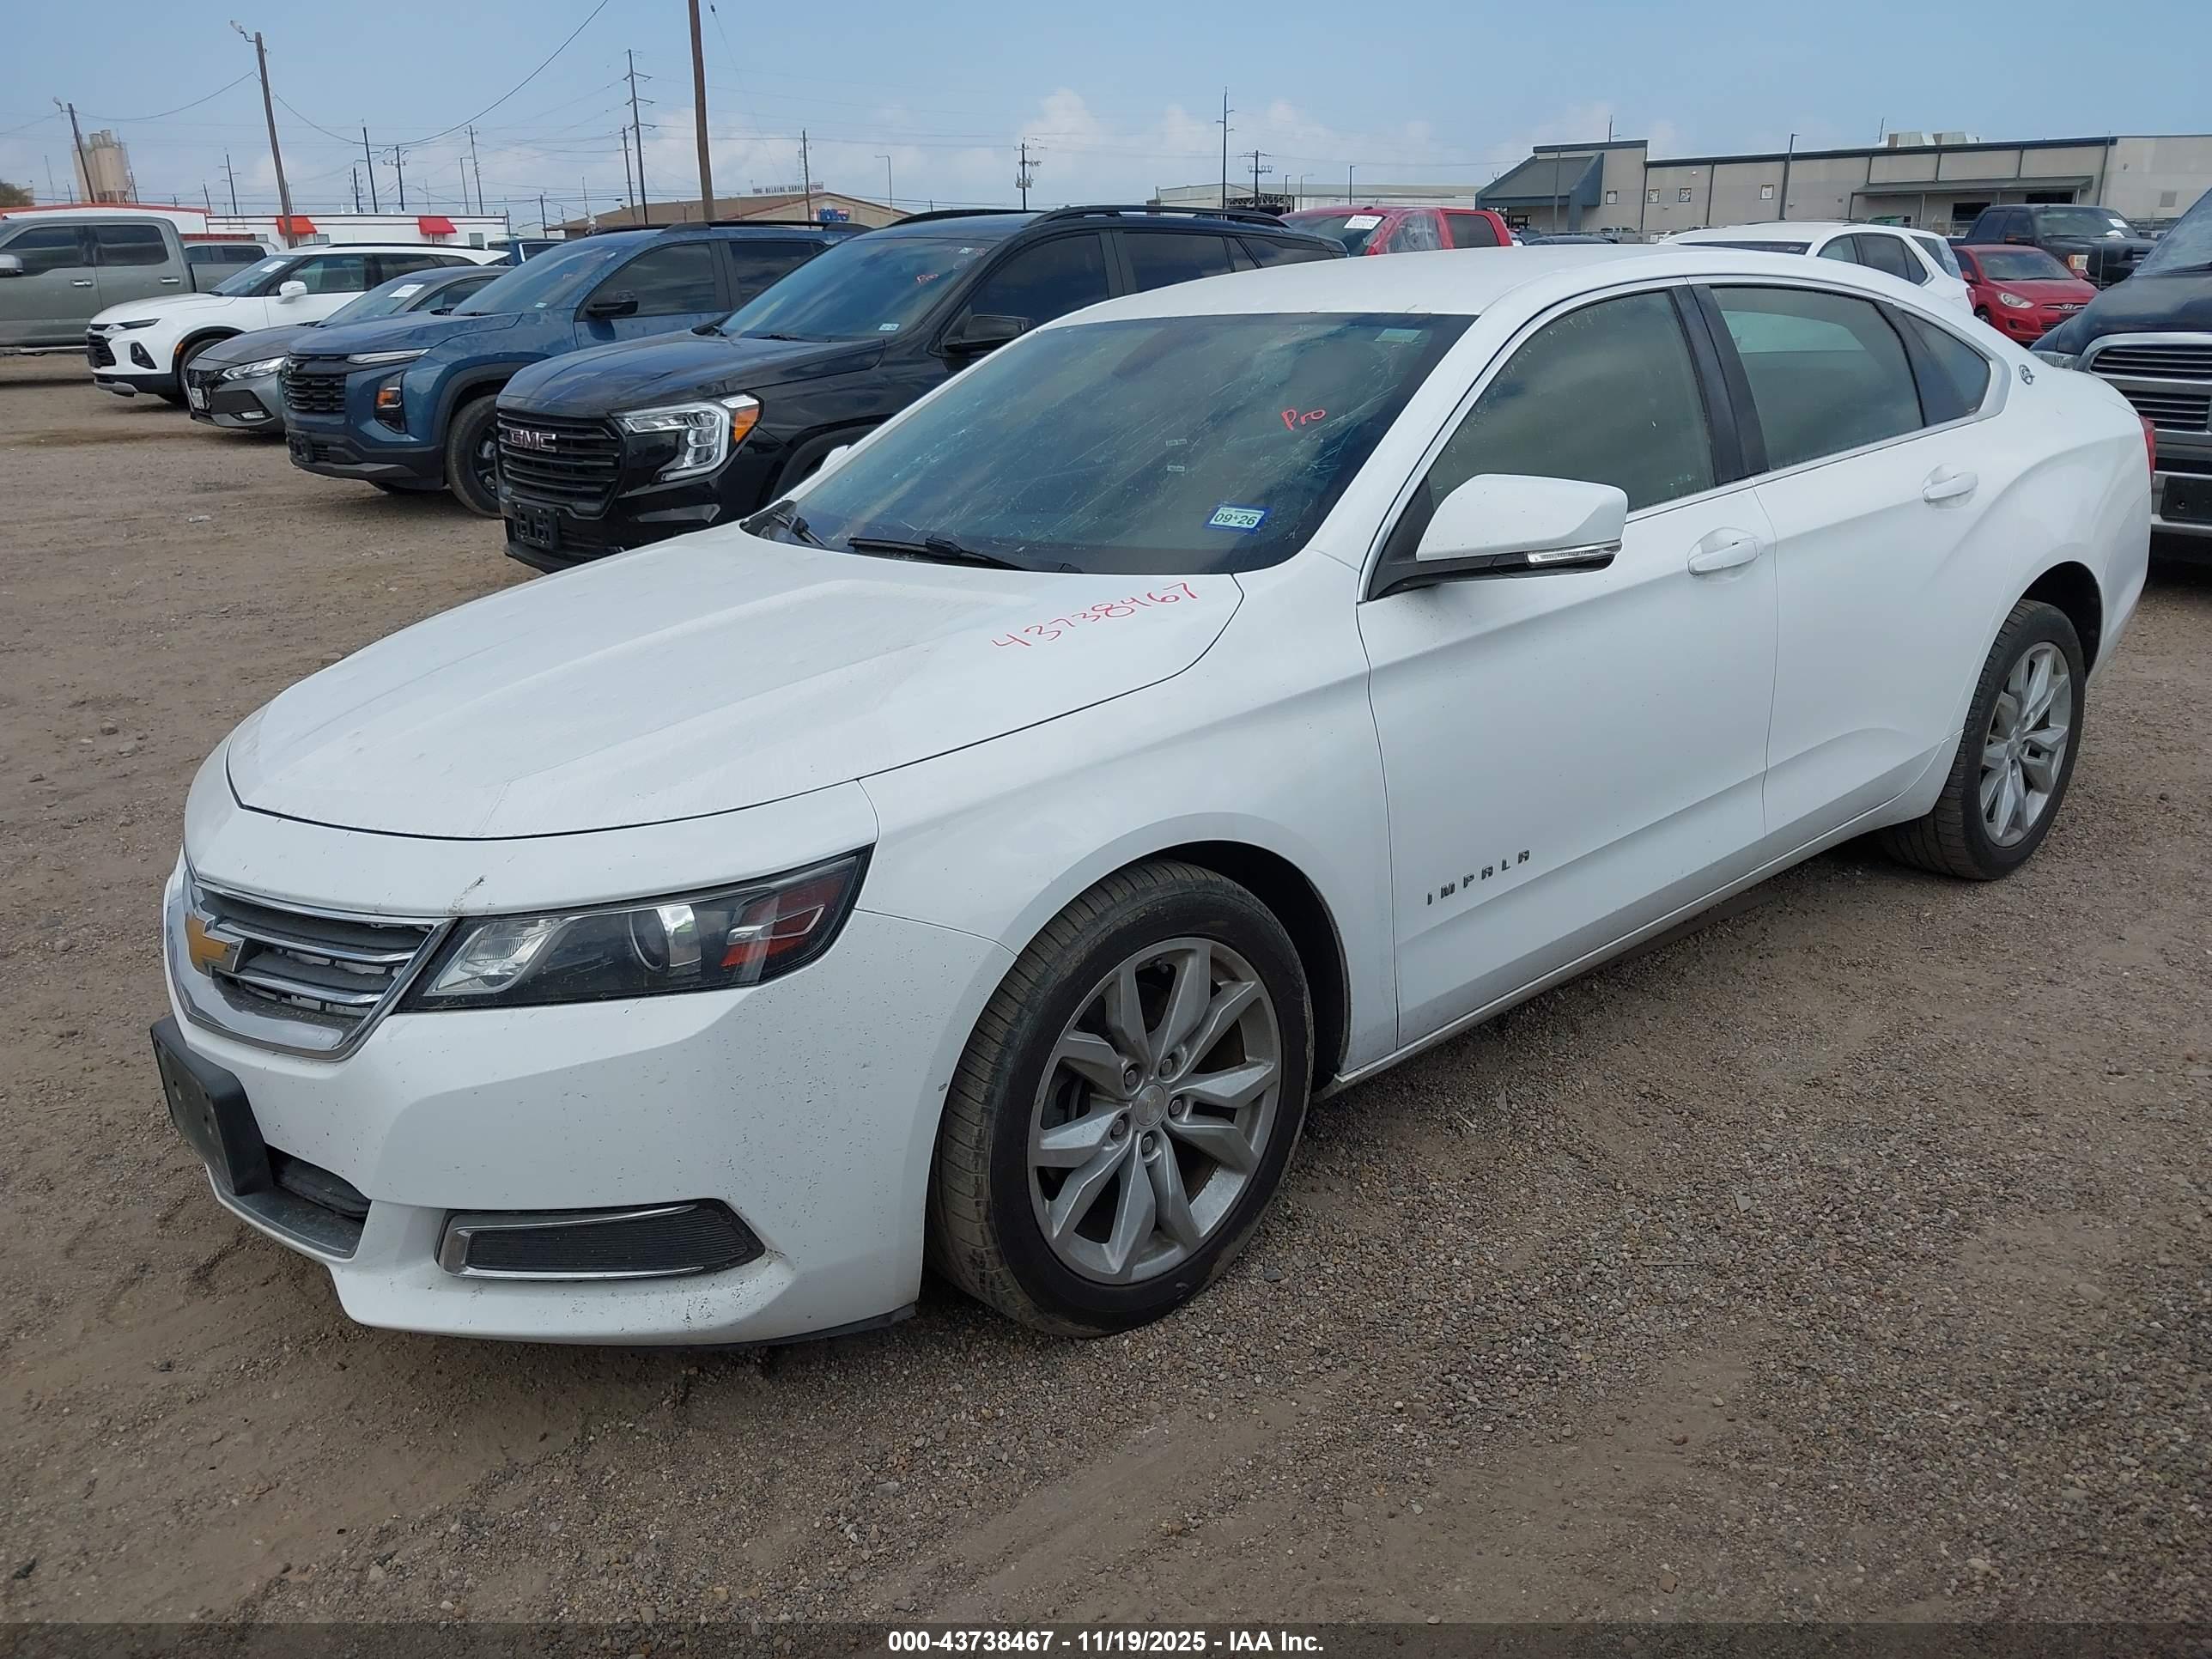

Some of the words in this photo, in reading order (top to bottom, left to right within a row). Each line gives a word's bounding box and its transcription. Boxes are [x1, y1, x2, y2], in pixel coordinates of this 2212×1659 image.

[1281, 409, 1327, 430] Pro
[510, 429, 556, 453] GMC
[991, 582, 1199, 647] 43738467
[1427, 849, 1530, 906] IMPALA
